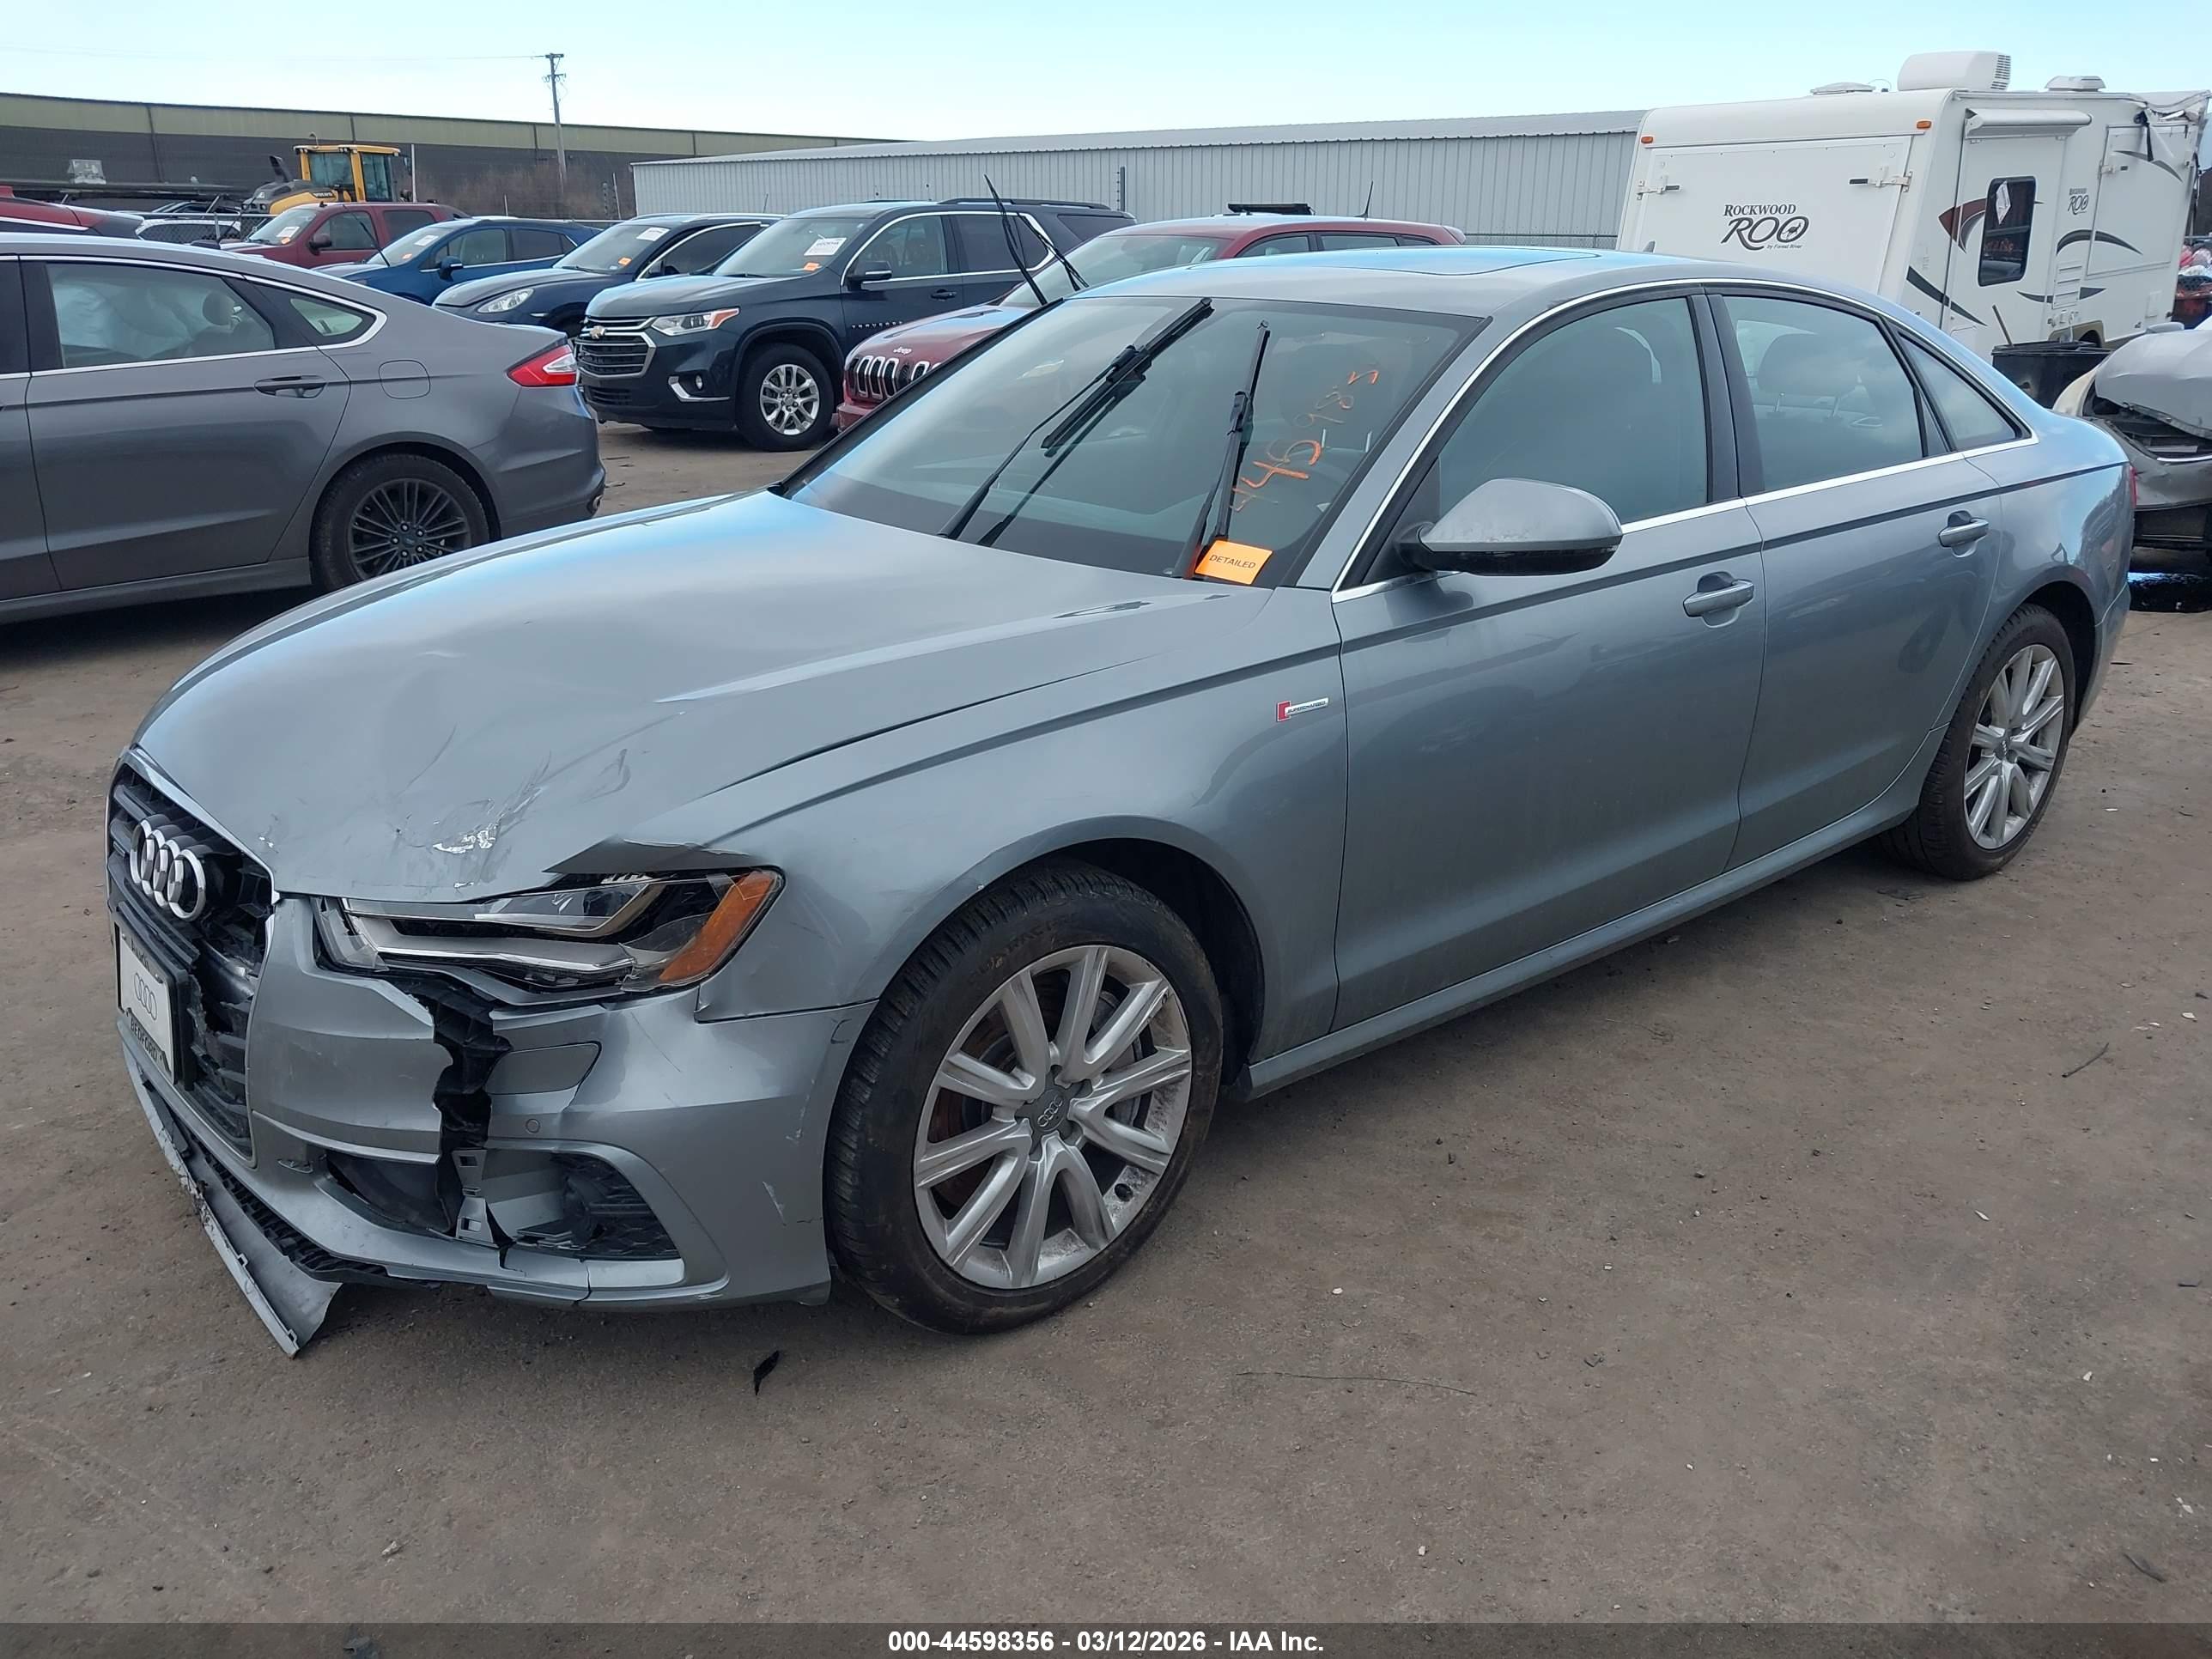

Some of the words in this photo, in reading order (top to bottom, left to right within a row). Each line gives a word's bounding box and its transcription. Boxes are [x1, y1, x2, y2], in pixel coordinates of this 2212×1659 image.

[1723, 204, 1796, 216] ROCKWOOD
[1721, 216, 1809, 251] ROO
[893, 346, 912, 355] Jeep
[1209, 554, 1256, 568] DETAILED
[131, 1018, 157, 1061] BEDFORD
